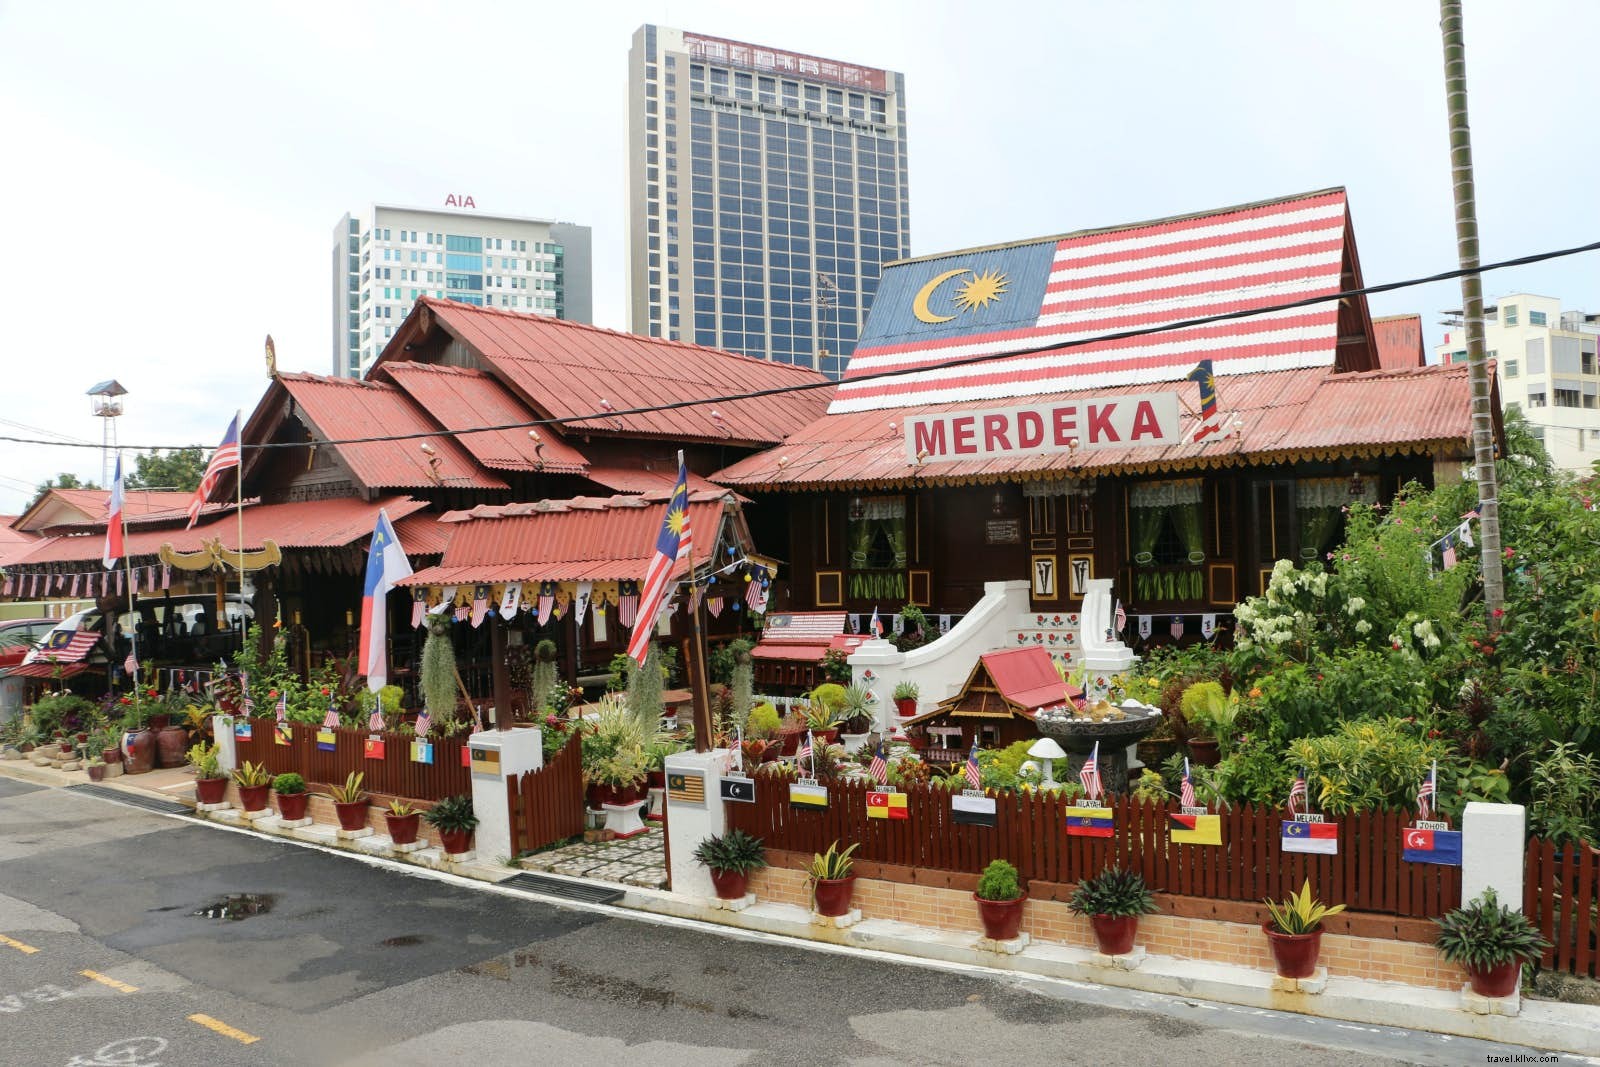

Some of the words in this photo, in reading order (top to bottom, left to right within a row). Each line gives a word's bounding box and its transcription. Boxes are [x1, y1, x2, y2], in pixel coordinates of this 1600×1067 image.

[445, 193, 475, 208] AIA
[914, 400, 1163, 456] MERDEKA
[1296, 814, 1322, 822] MELAKA
[1420, 822, 1446, 830] JOHOR
